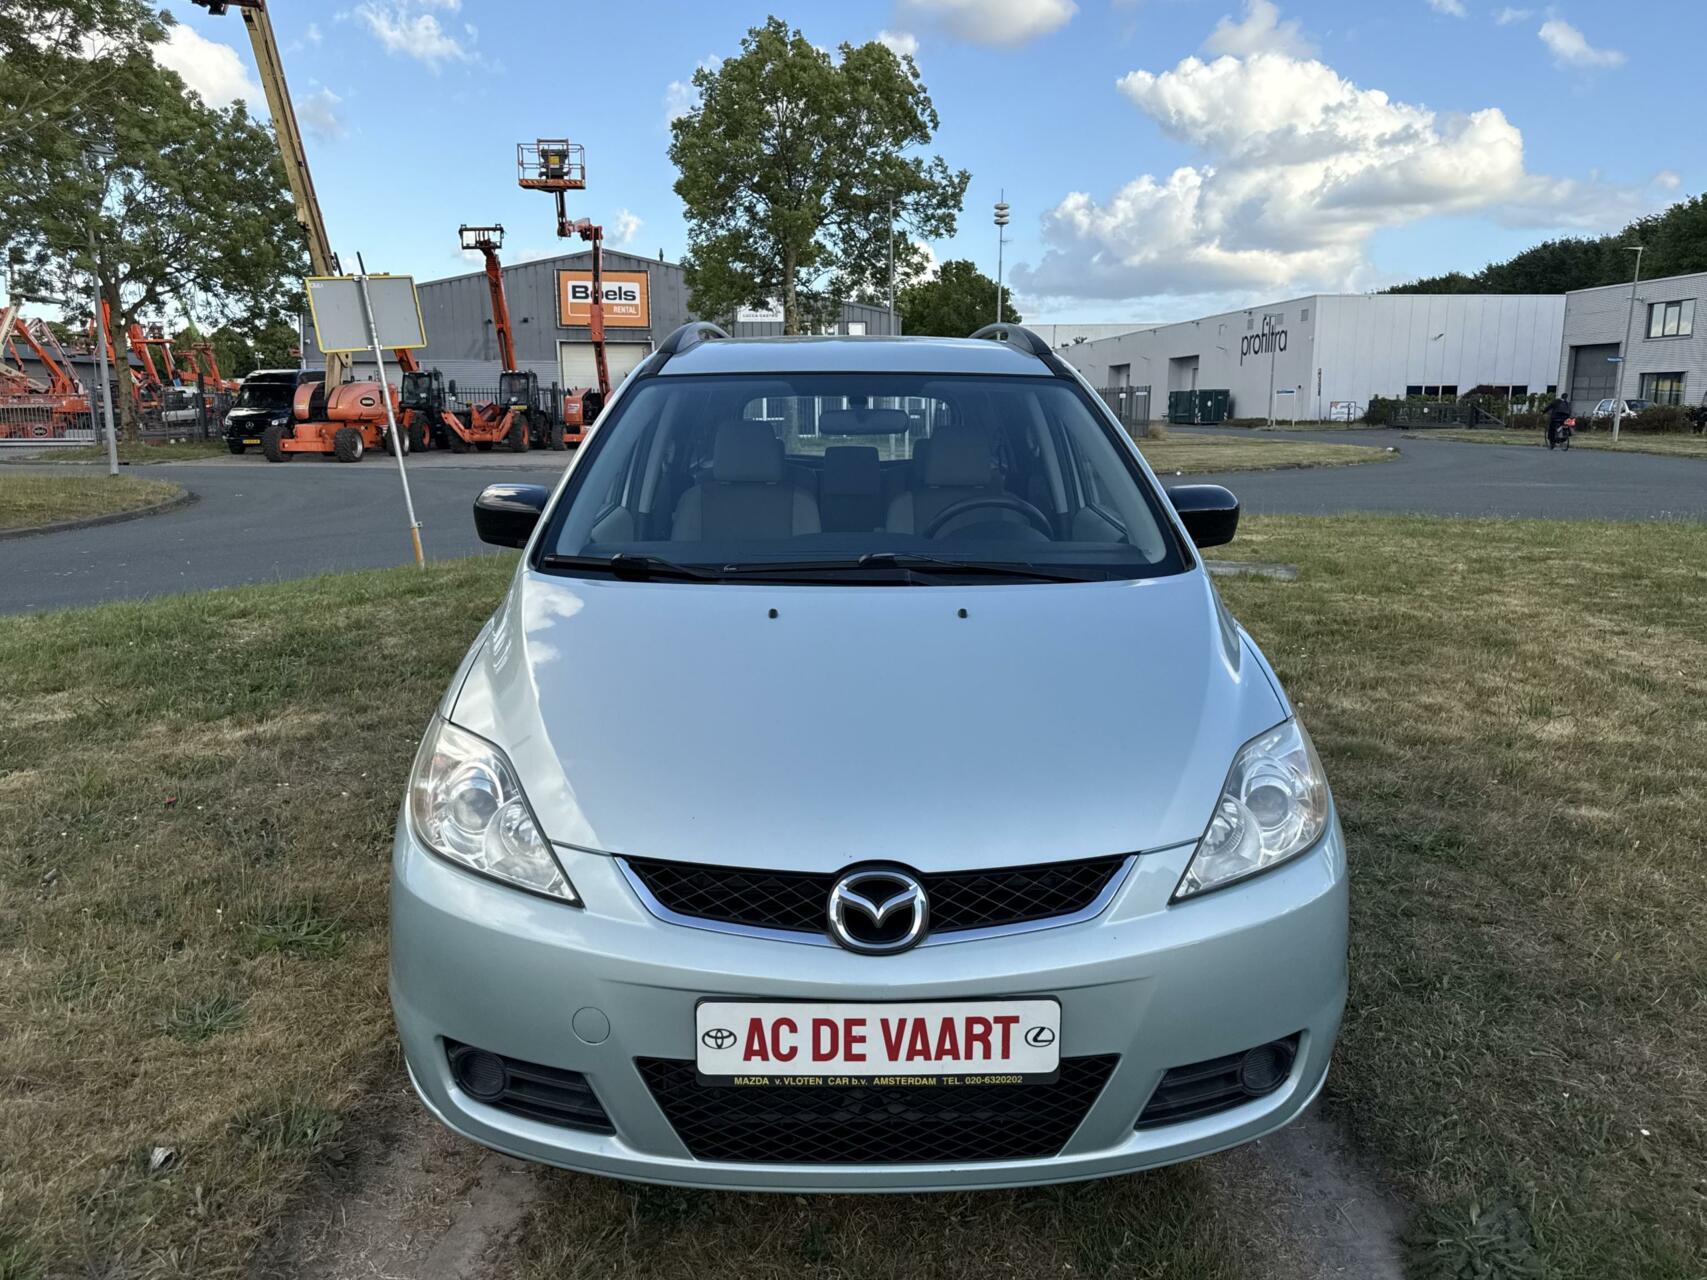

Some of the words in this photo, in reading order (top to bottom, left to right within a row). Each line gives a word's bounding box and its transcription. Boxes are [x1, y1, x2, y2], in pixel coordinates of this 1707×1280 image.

[613, 305, 637, 314] RENTAL
[1240, 316, 1288, 367] profiltra
[743, 1017, 798, 1062] AC
[811, 1017, 867, 1062] DE
[880, 1015, 1020, 1062] VAART
[734, 1077, 769, 1085] MAZDA
[784, 1077, 823, 1085] VLOTEN
[827, 1077, 849, 1085] CAR
[851, 1077, 868, 1085] b.v.
[873, 1076, 937, 1085] AMSTERDAM
[942, 1076, 963, 1085] TEL.
[965, 1075, 1023, 1084] 020-6320202
